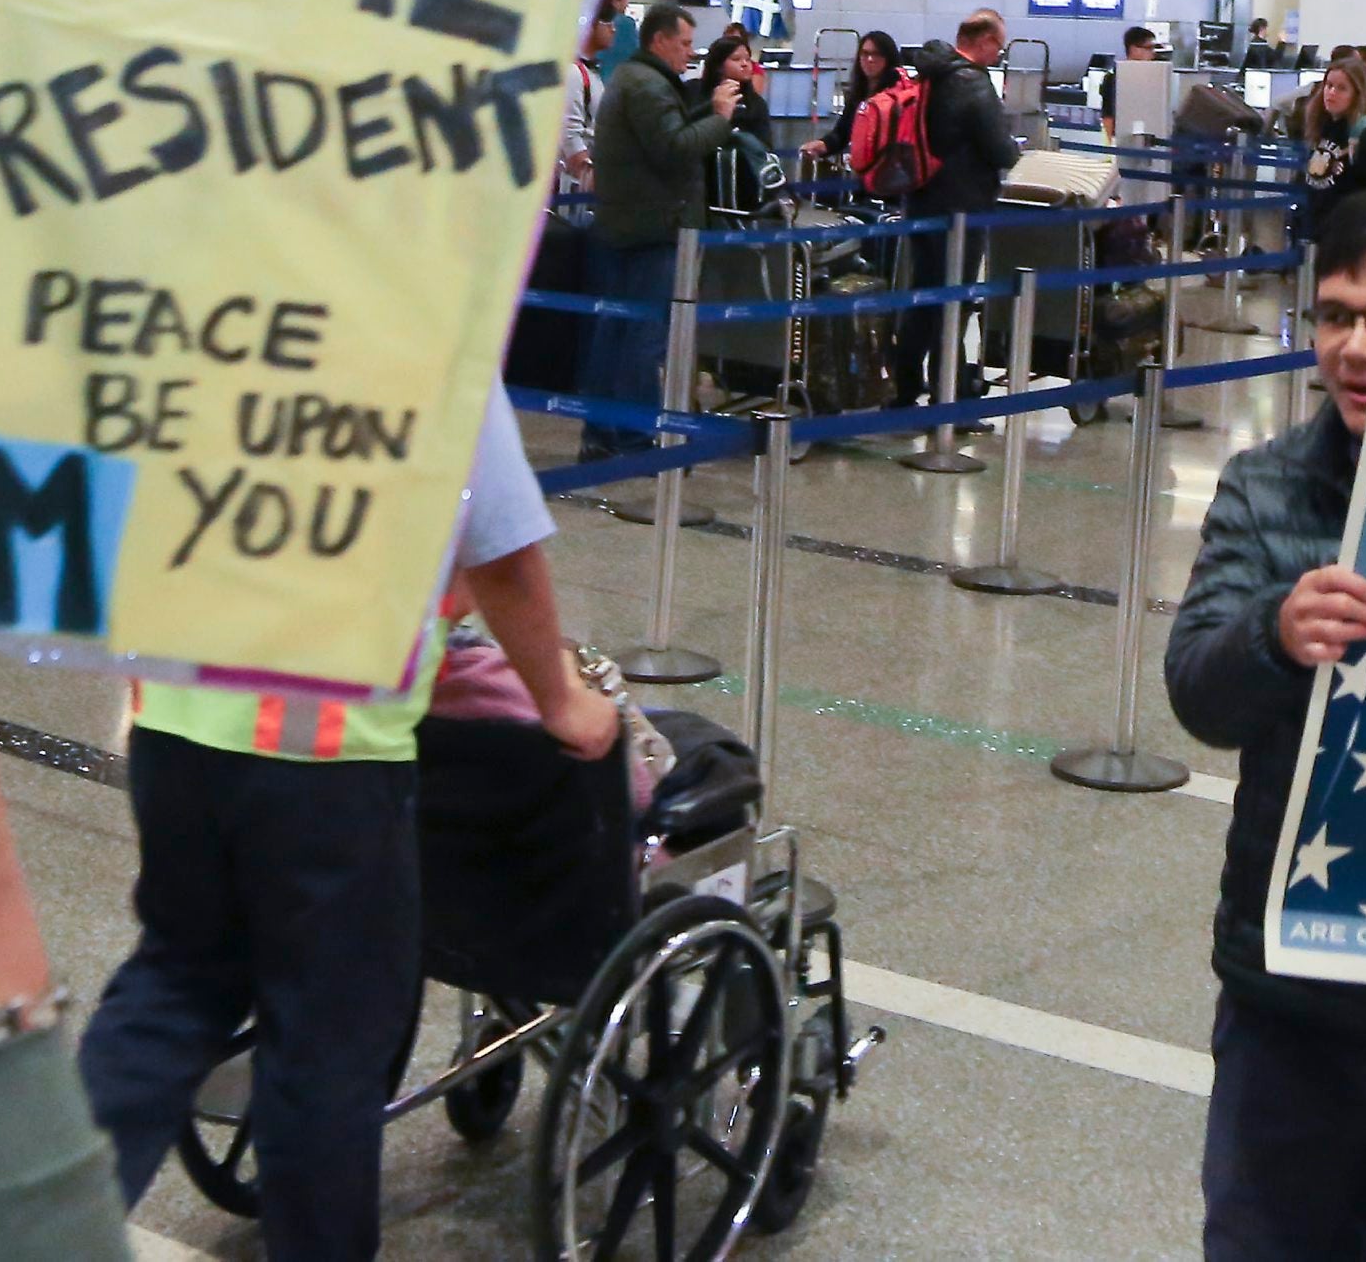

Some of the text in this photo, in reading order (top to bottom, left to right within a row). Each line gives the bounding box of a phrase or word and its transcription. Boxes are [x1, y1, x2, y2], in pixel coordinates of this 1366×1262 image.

[21, 269, 331, 374] PEACE
[83, 372, 418, 461] BE UPON
[166, 466, 373, 572] YOU
[1289, 919, 1347, 945] ARE
